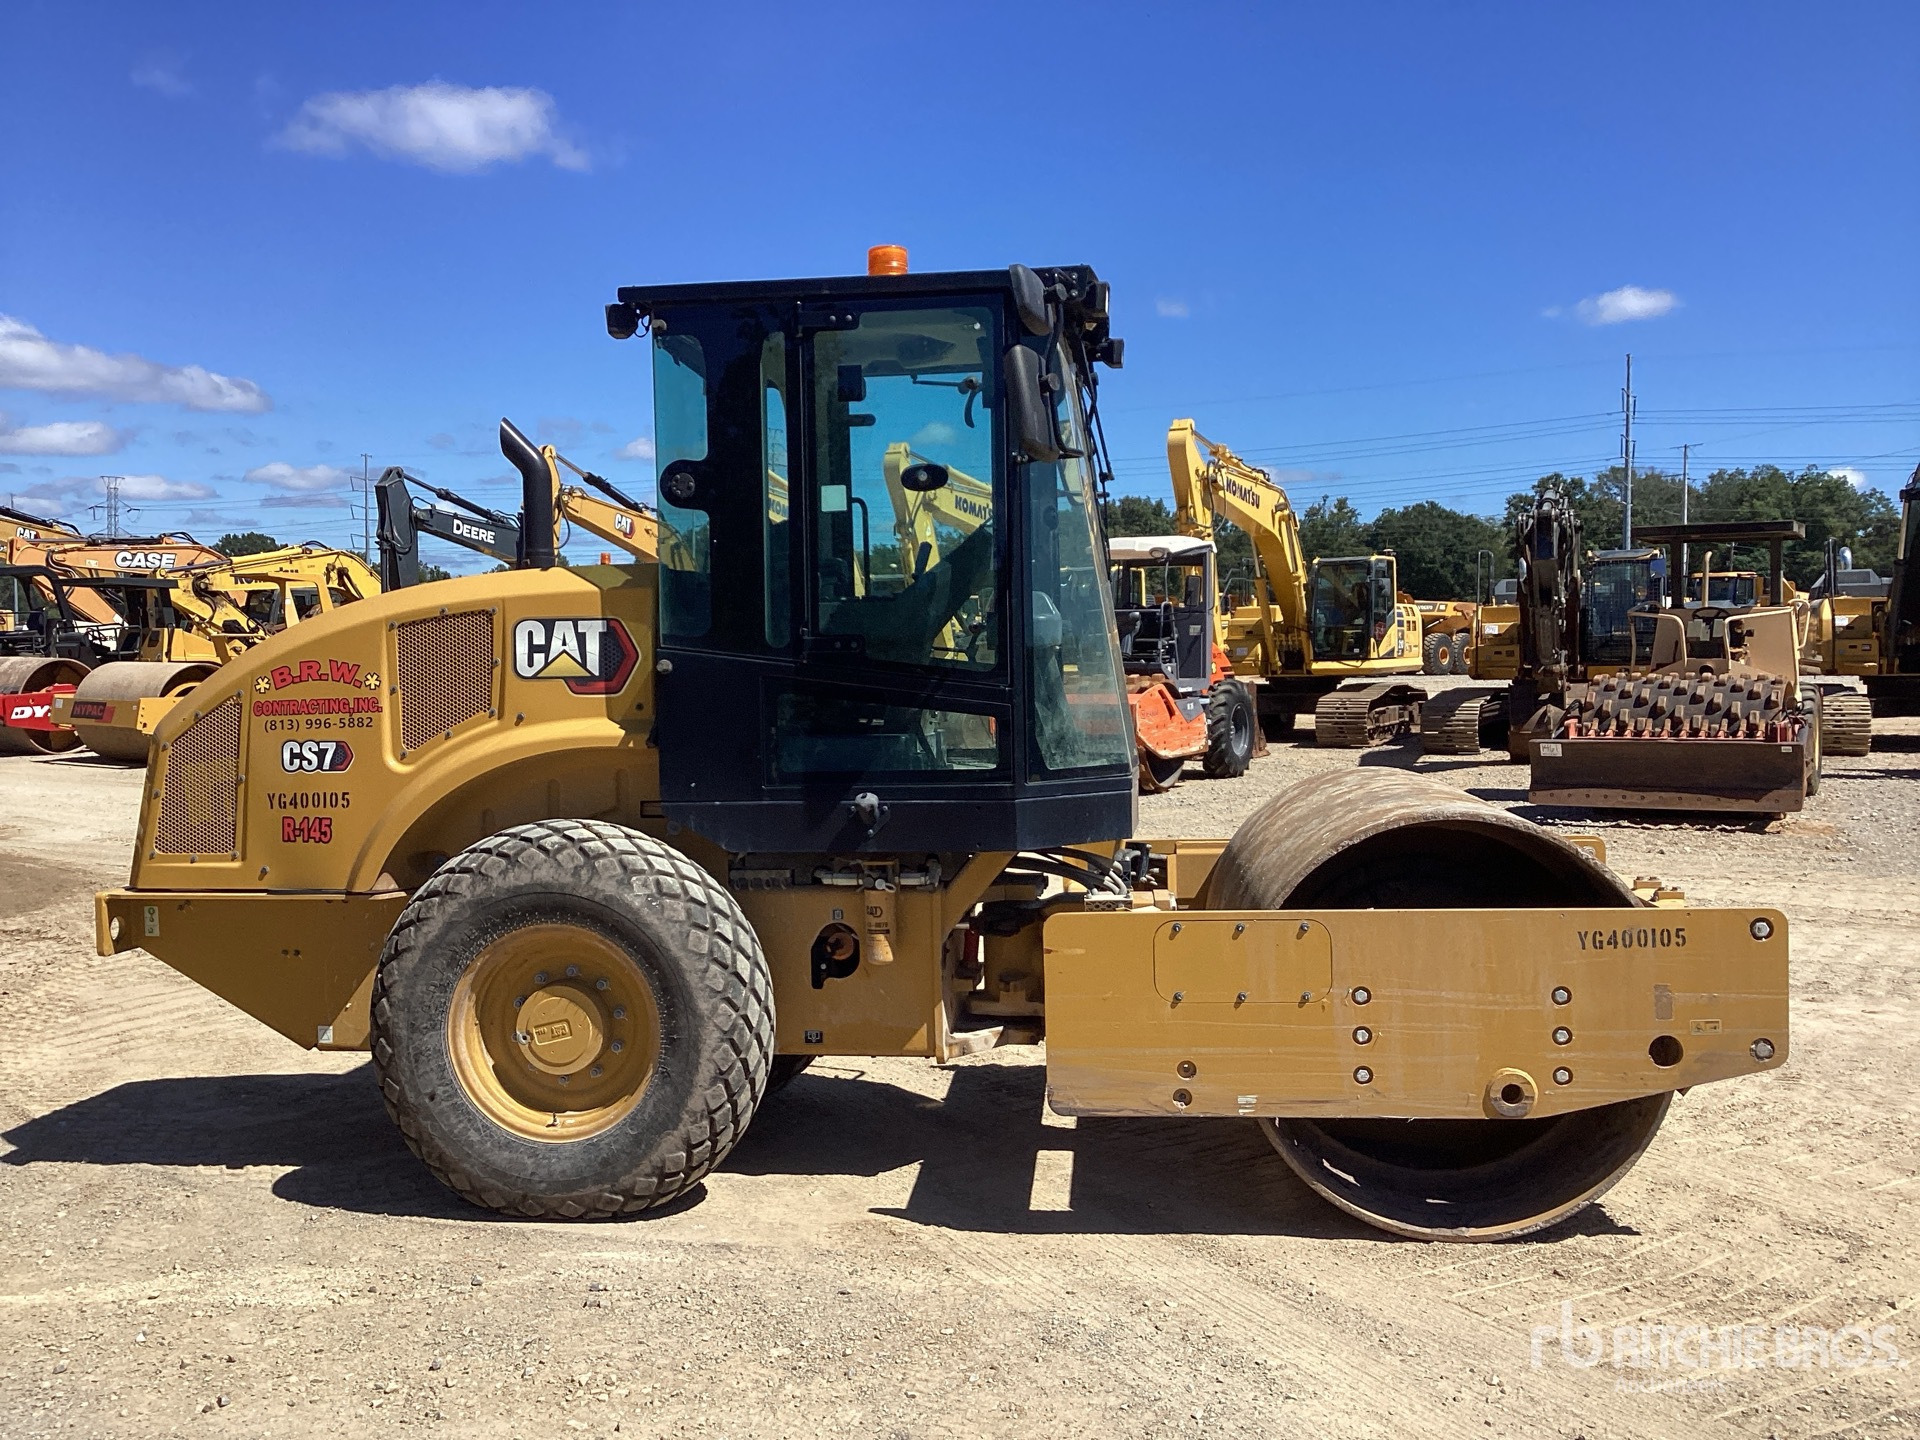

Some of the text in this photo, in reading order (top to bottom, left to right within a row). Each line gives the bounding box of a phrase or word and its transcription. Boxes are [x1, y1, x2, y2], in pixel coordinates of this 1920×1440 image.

[1226, 476, 1260, 509] KOMATSU
[16, 527, 36, 539] CAT
[453, 519, 495, 544] DEERE
[615, 514, 632, 534] CAT
[115, 551, 176, 568] CASE
[515, 620, 607, 677] CAT
[271, 659, 363, 690] B.R.W.
[11, 705, 51, 719] DY
[72, 703, 104, 716] HYPAC
[264, 717, 373, 733] (813) 996-5882
[282, 741, 337, 771] CS7
[267, 791, 350, 809] YG400105
[282, 816, 332, 844] R-145
[1577, 927, 1686, 950] YG400105
